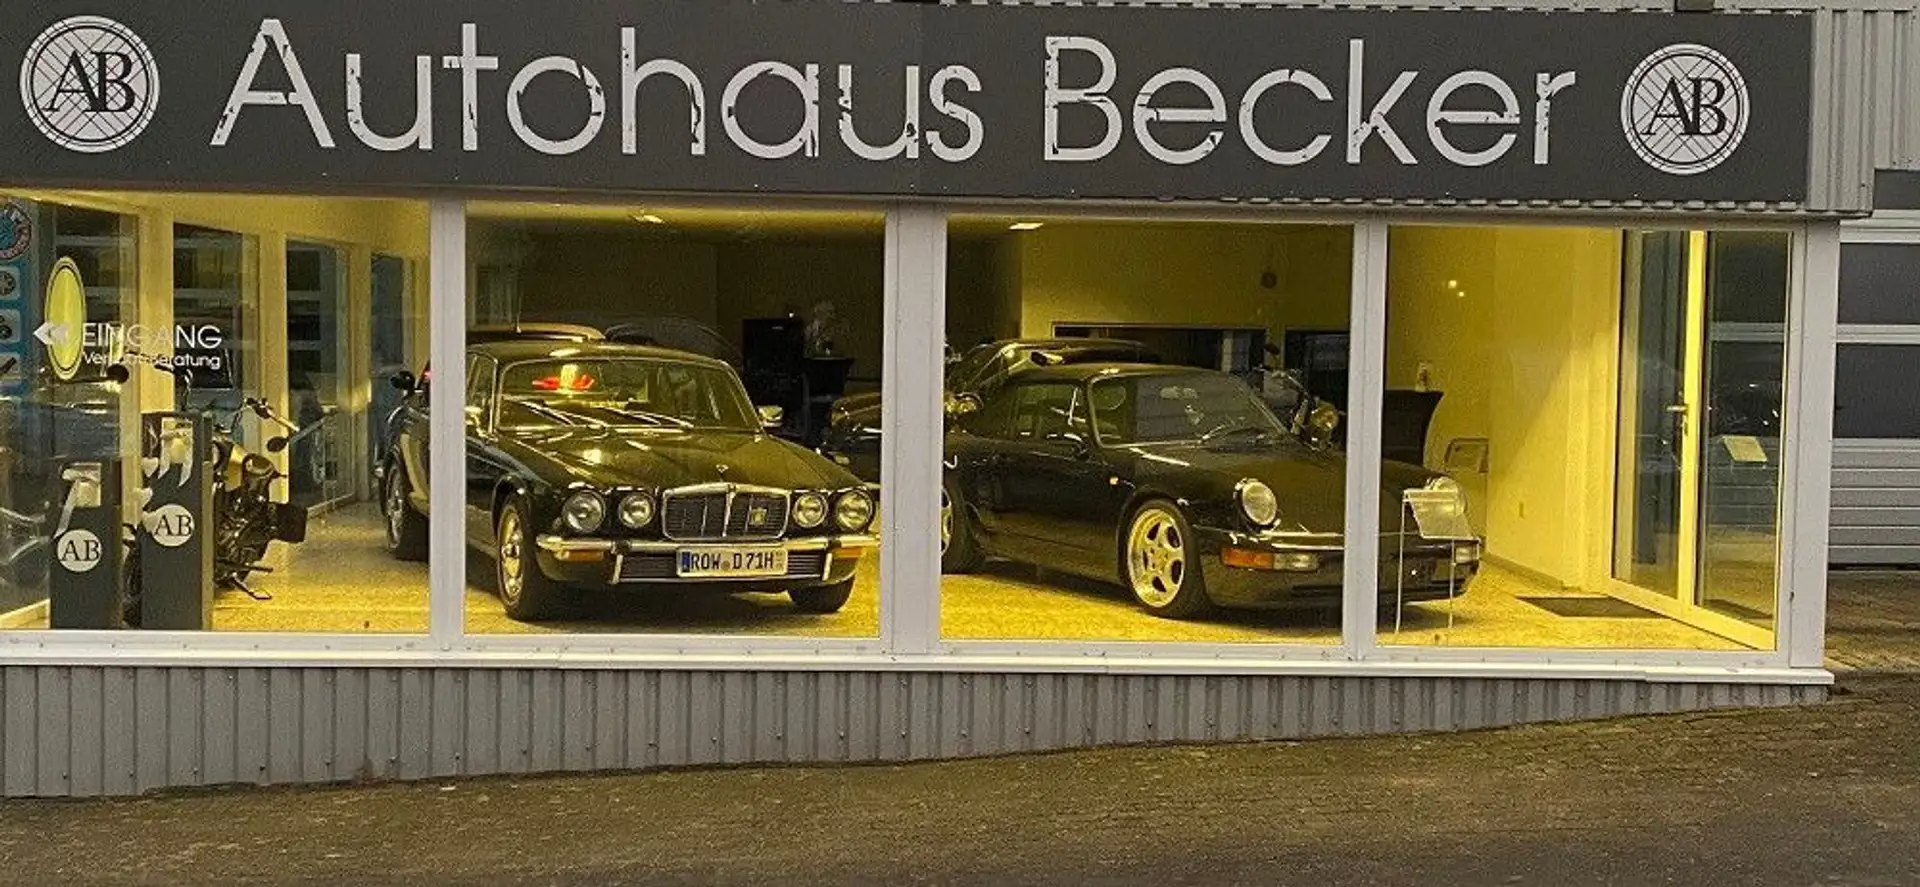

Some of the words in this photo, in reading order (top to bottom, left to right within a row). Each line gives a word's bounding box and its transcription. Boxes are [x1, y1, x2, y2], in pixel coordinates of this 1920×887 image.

[45, 50, 137, 114] AB
[209, 18, 985, 162] Autohaus
[1043, 35, 1576, 165] Becker
[1640, 76, 1729, 137] AB
[82, 322, 222, 349] EINGANG
[149, 352, 221, 370] eratung
[156, 514, 193, 537] AB
[61, 539, 100, 561] AB
[691, 553, 720, 570] ROW
